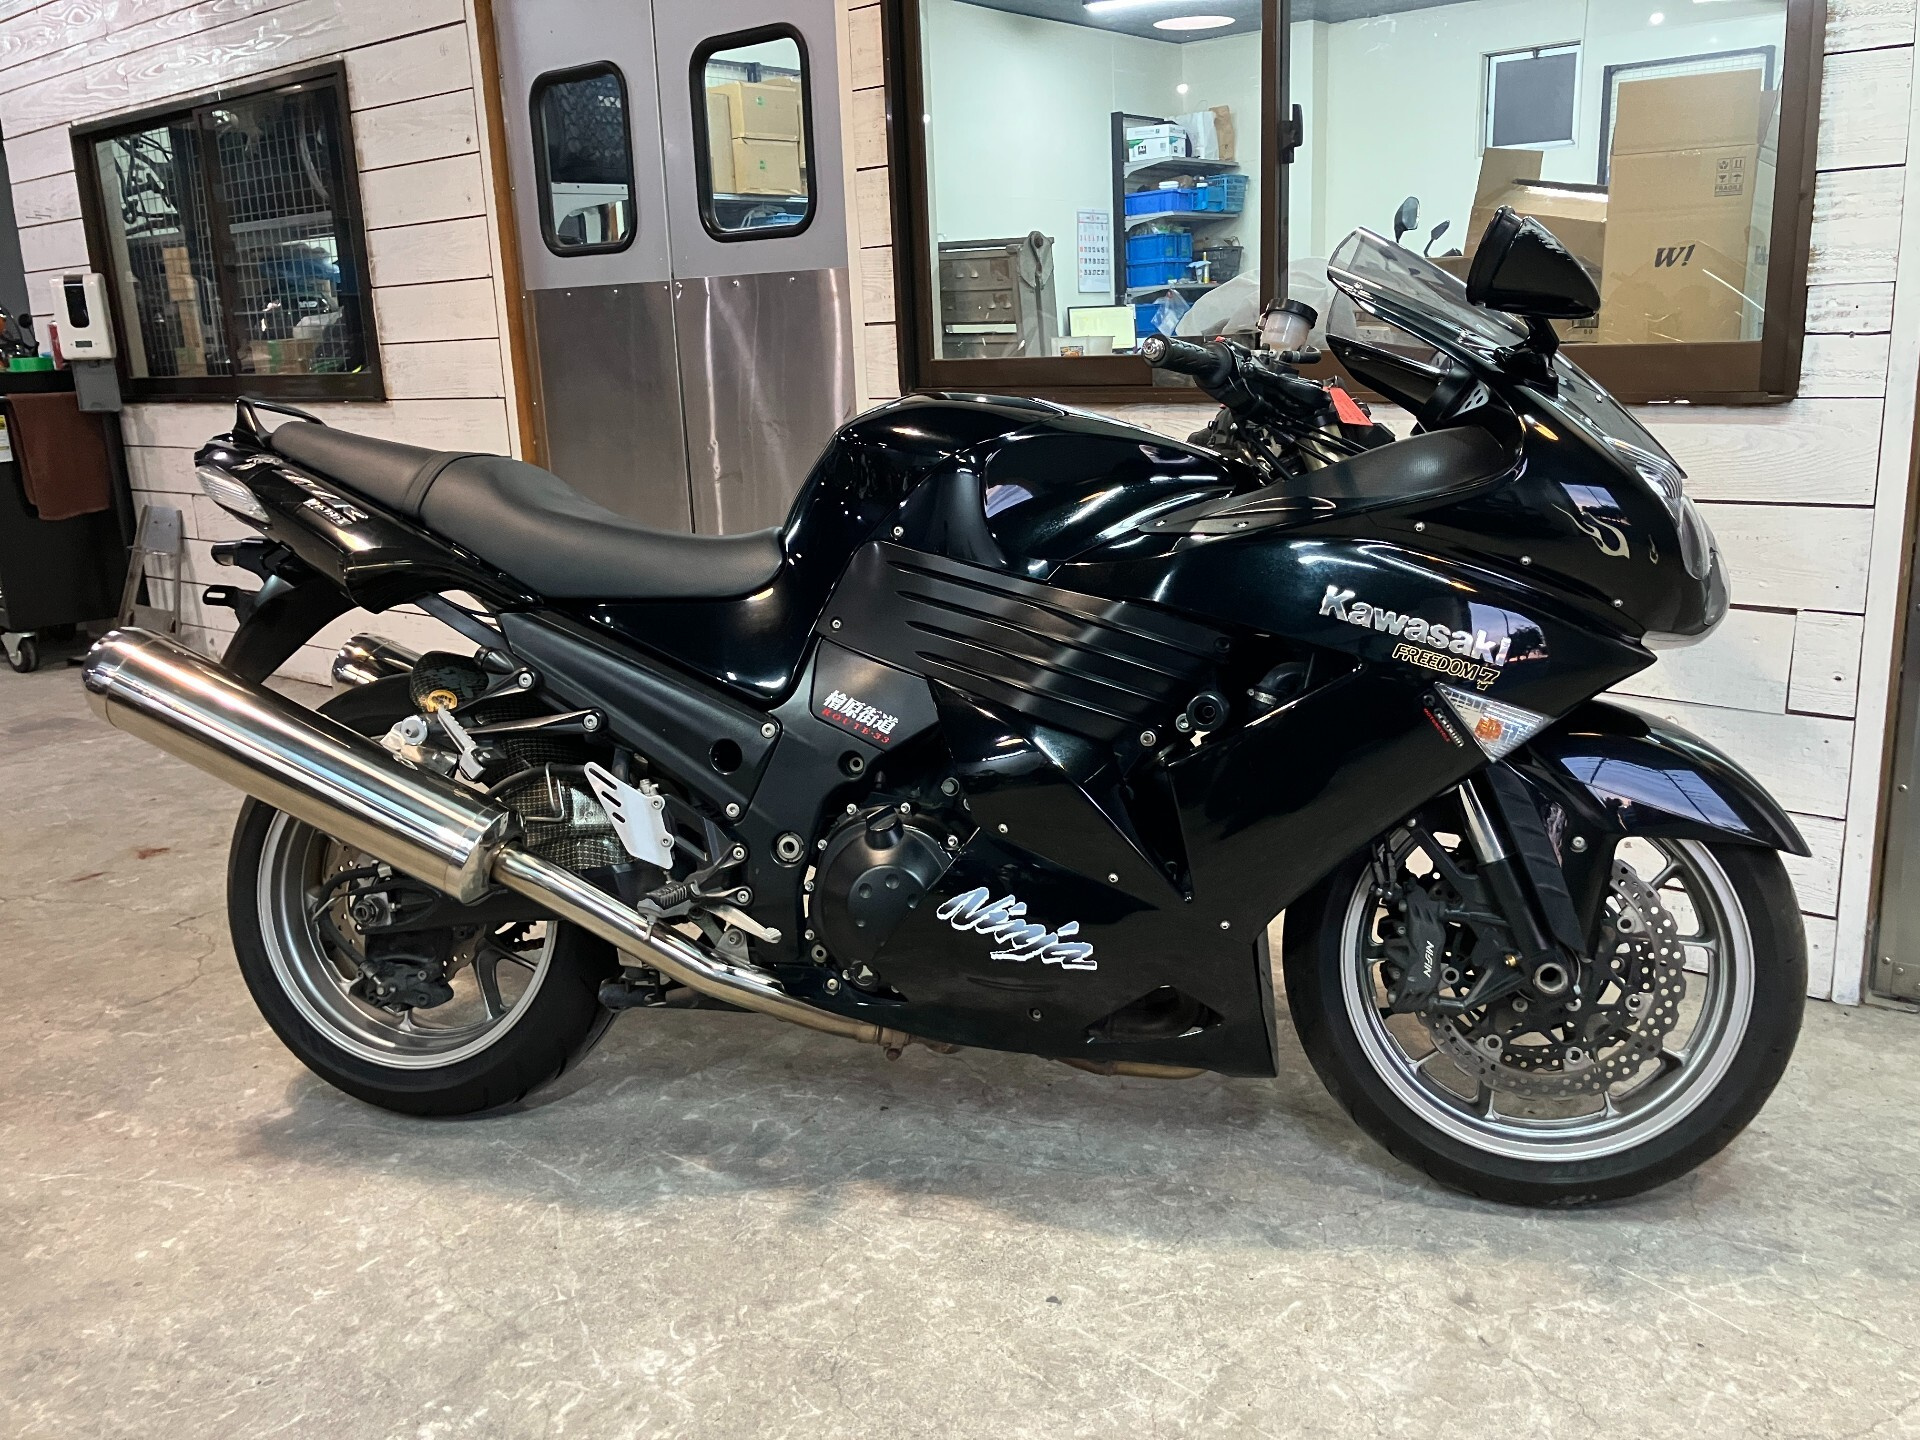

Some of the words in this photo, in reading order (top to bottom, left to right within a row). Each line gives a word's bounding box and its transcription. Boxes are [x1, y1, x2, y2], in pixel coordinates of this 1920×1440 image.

[1654, 244, 1695, 268] W!
[1319, 584, 1512, 667] Kawasaki
[936, 886, 1098, 971] Ninja
